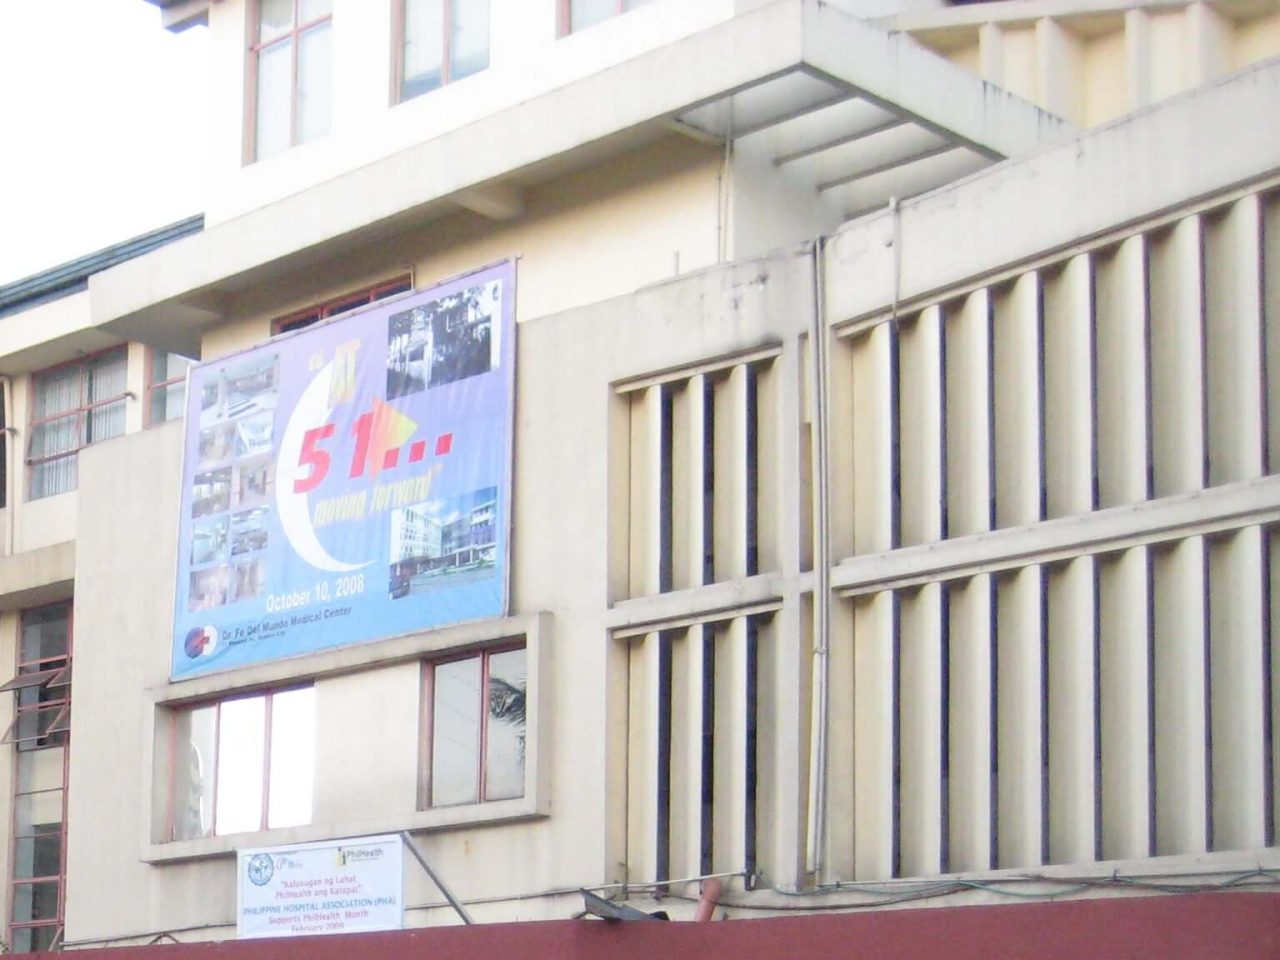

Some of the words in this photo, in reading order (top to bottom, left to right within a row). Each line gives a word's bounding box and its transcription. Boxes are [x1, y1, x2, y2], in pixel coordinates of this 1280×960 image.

[266, 590, 310, 612] October
[315, 582, 332, 604] 10,
[336, 573, 365, 598] 2008
[222, 630, 232, 641] Dr.
[234, 627, 245, 638] Fe
[247, 623, 261, 637] Del
[262, 618, 289, 633] Mundo
[290, 610, 322, 627] Medical
[323, 605, 353, 620] Center
[314, 888, 328, 898] ang
[243, 903, 281, 915] PHILIPPINE
[283, 901, 319, 913] HOSPITAL
[321, 897, 373, 910] ASSOCIATION
[268, 914, 301, 925] Supports
[303, 911, 341, 923] PhilHealth
[344, 909, 369, 919] Month
[291, 922, 322, 934] February
